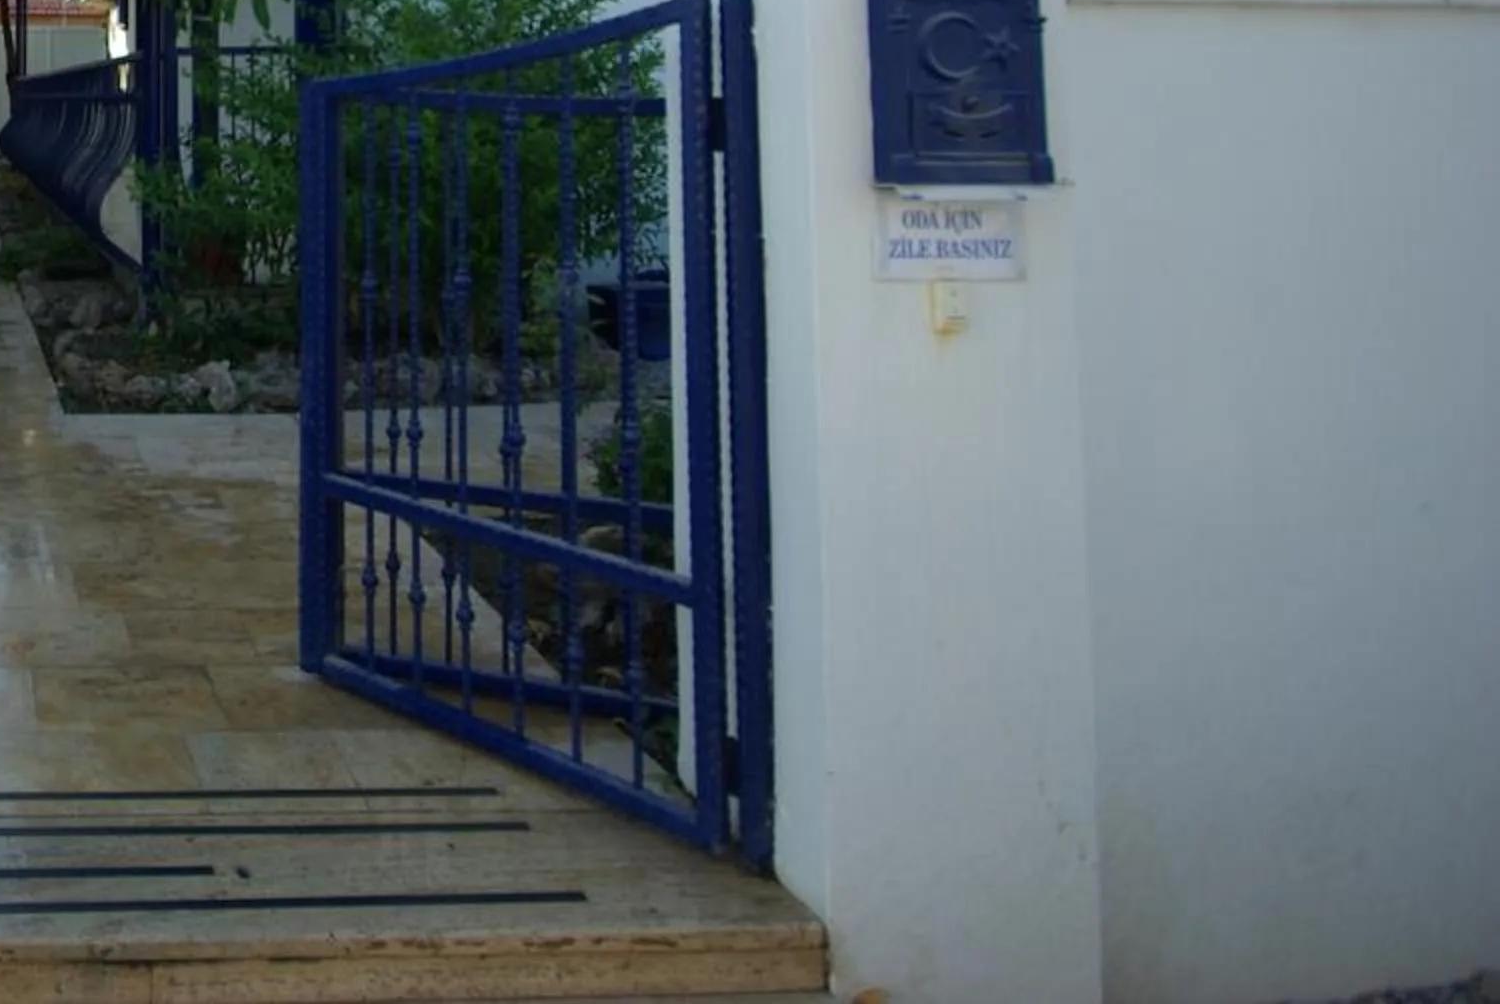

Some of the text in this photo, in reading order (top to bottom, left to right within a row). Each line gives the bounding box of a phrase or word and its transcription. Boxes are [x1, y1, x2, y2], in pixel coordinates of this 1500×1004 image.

[901, 208, 940, 230] ODA
[888, 236, 1014, 260] ZİLE BASINIZ
